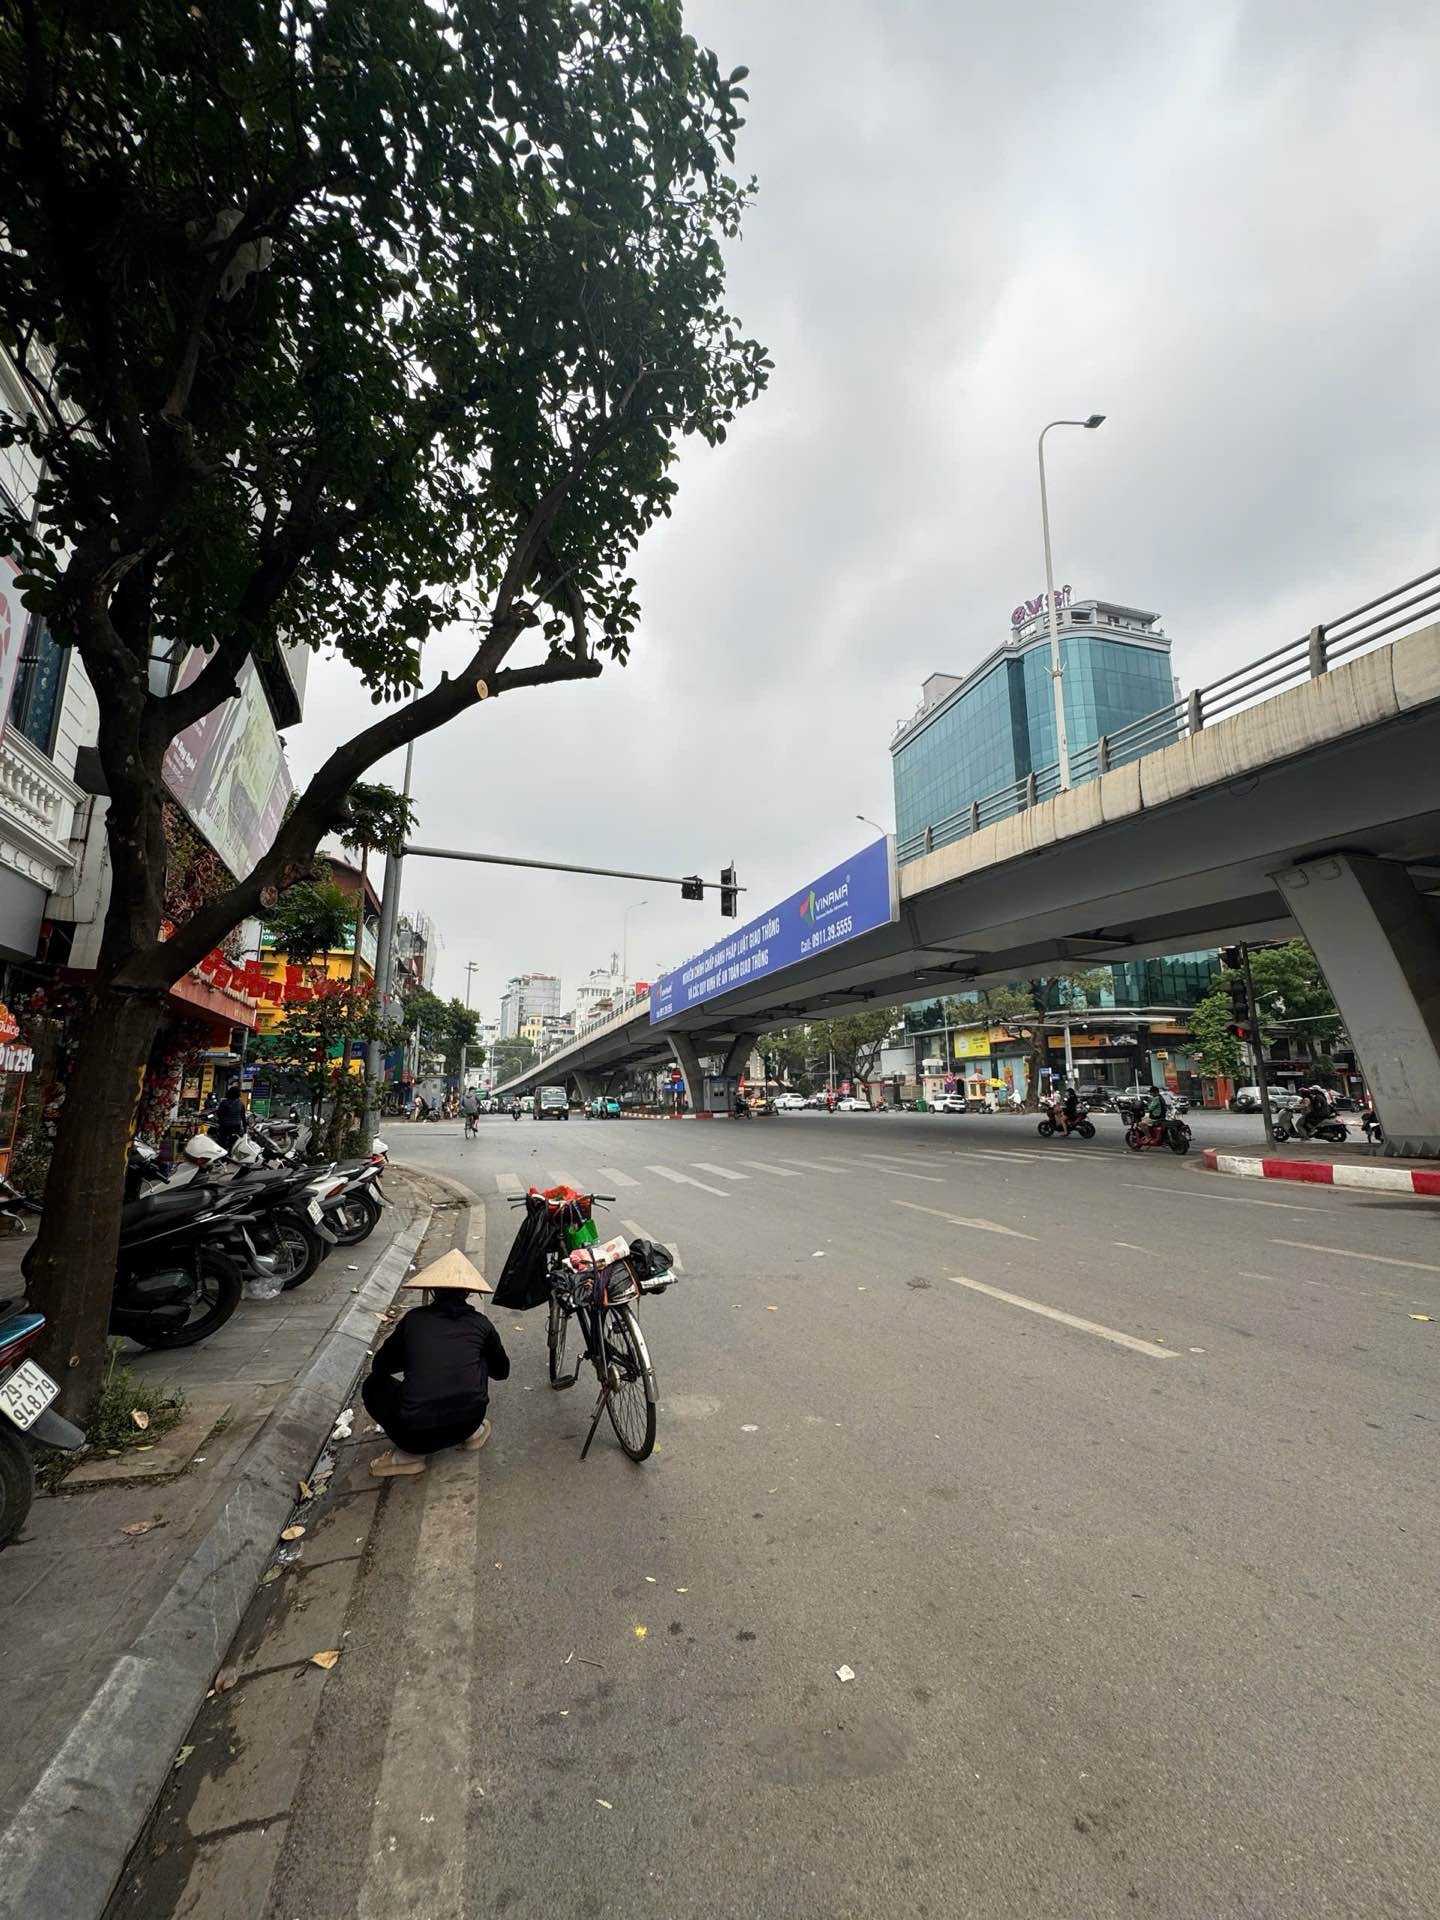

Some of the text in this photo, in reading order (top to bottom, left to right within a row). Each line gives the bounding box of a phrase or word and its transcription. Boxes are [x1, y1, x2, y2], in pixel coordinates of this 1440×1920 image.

[815, 883, 848, 912] VINAMA
[749, 928, 761, 949] GIAO
[762, 917, 780, 942] THÔNG
[811, 916, 853, 948] 0911.39.5555
[751, 949, 769, 971] THÔNG
[1, 1367, 38, 1407] 29-X1
[13, 1379, 56, 1425] 948.79
